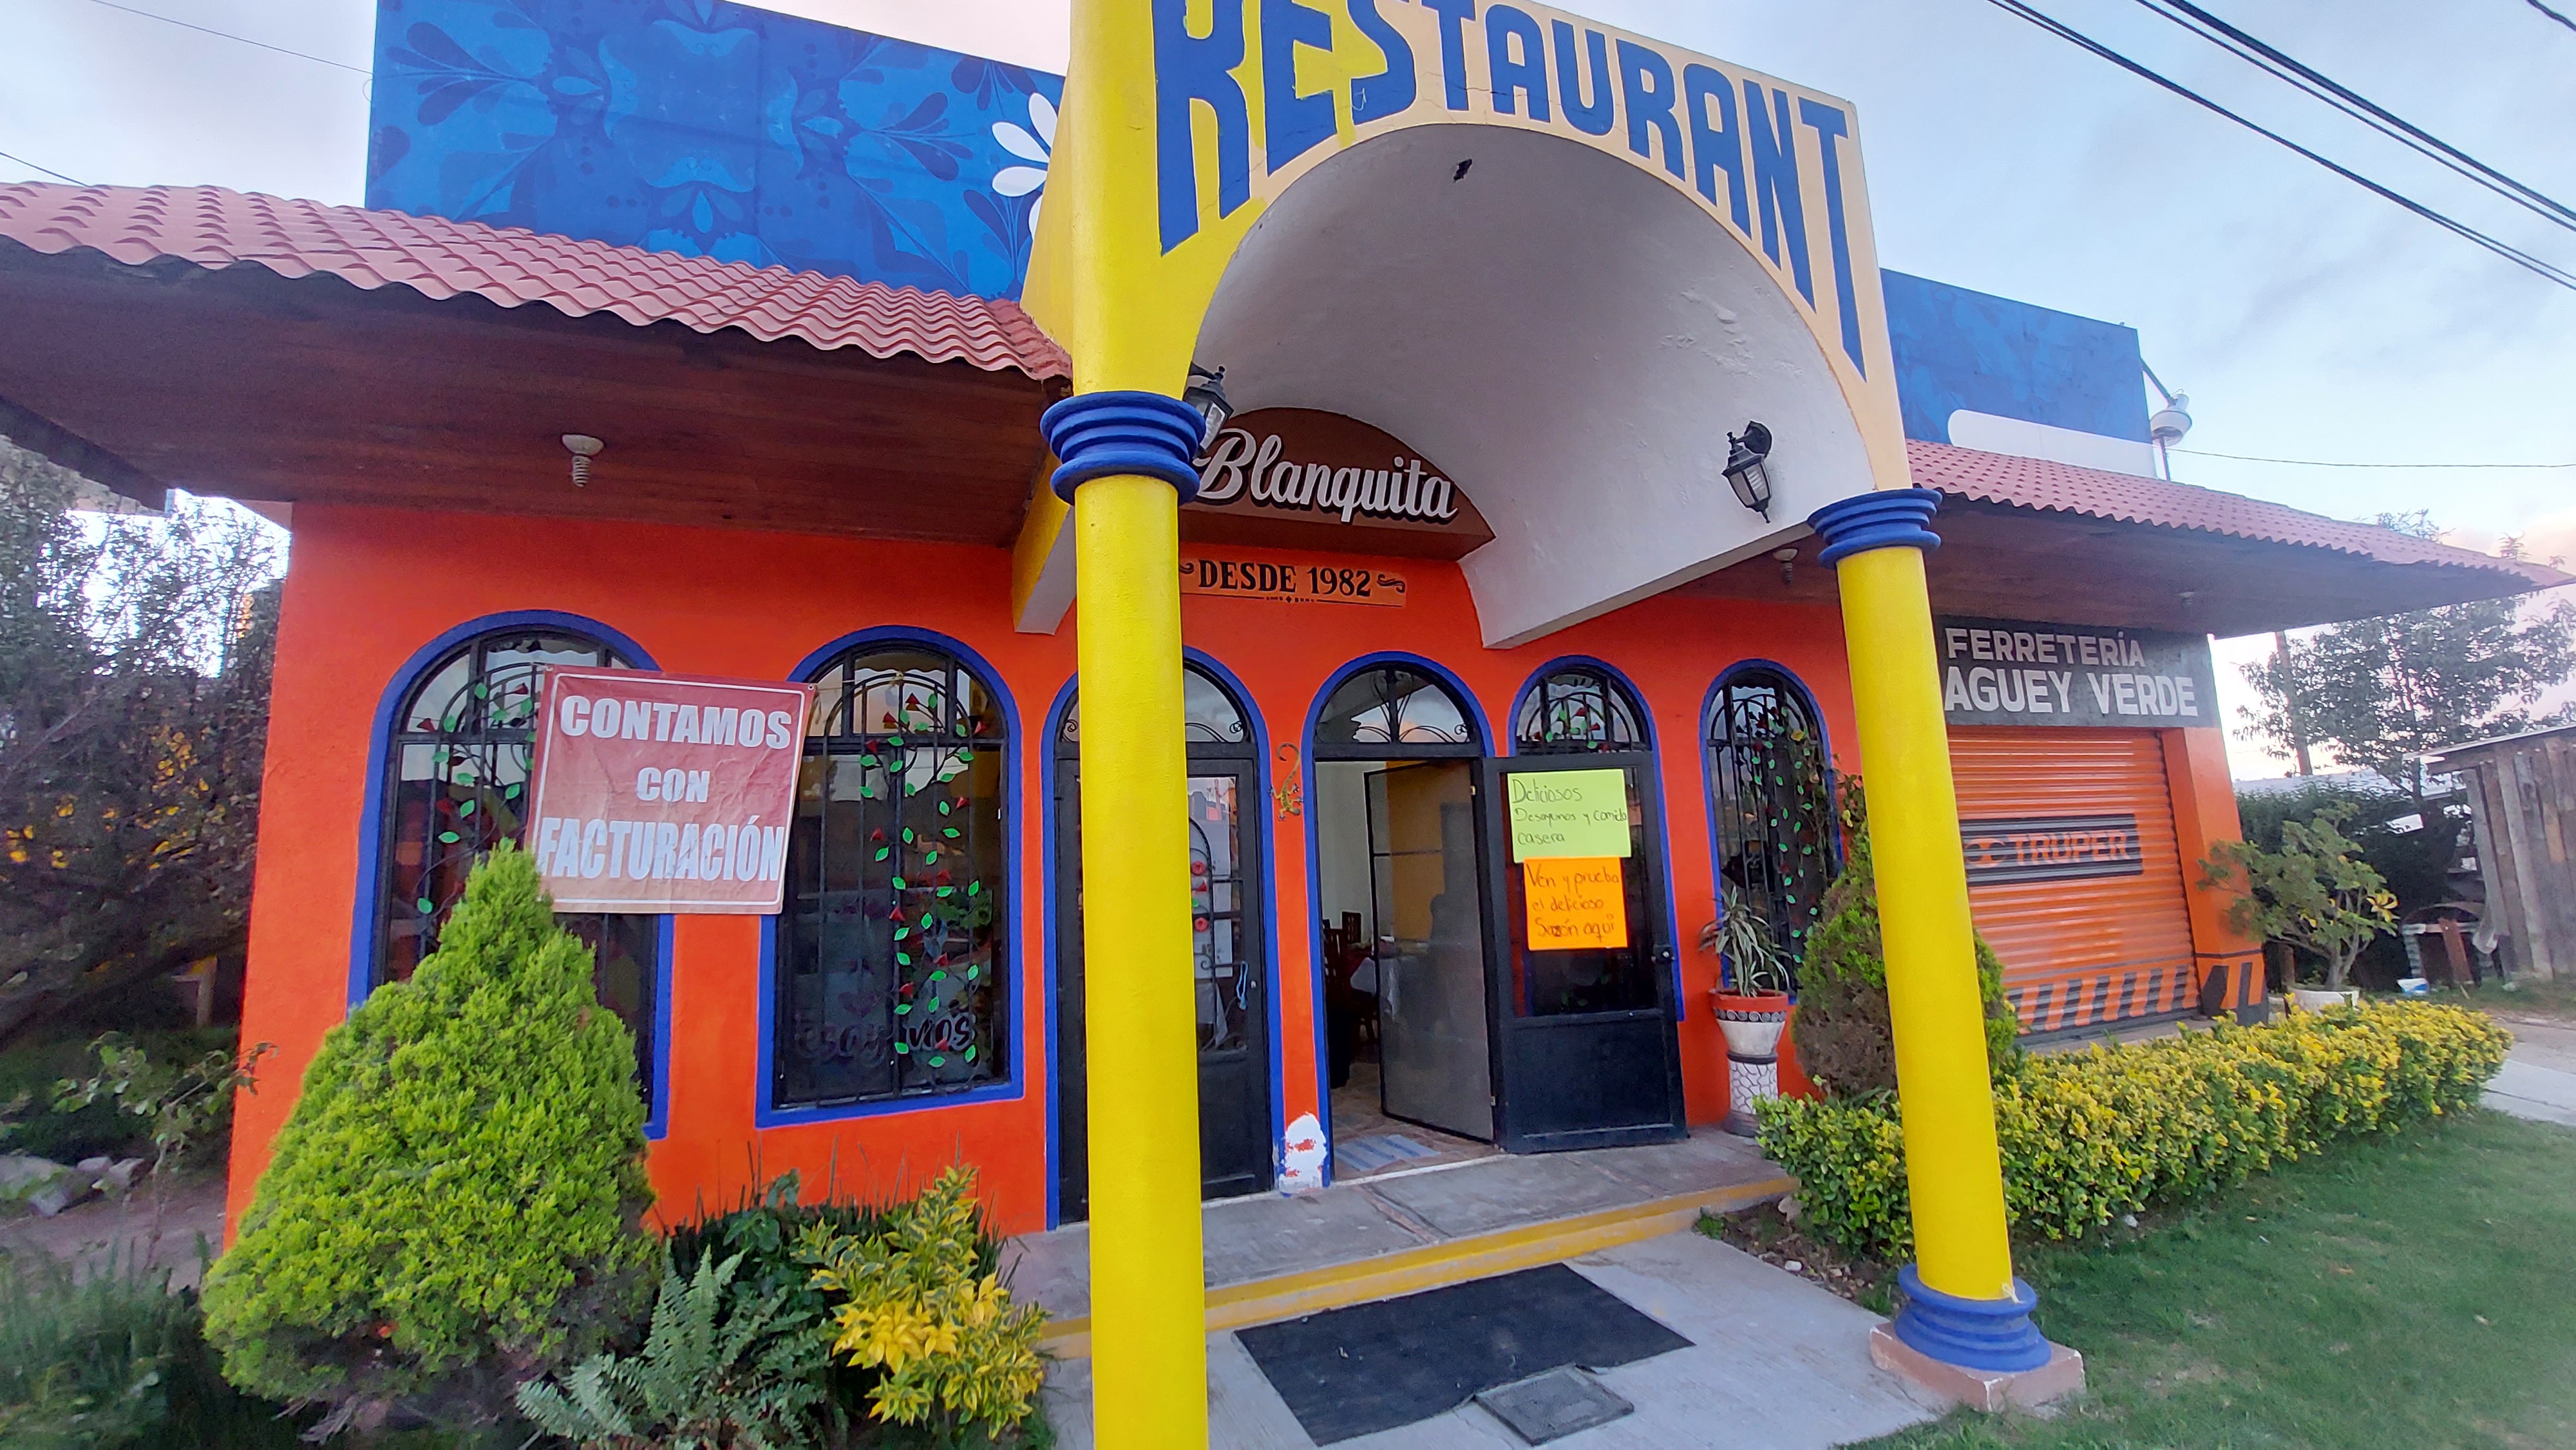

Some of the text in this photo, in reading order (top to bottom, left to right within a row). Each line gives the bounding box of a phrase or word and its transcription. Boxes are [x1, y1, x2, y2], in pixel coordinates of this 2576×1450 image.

[1153, 0, 1866, 383] RESTAURANT
[1193, 428, 1458, 522] Blanquita
[1198, 560, 1371, 597] DESDE 1982
[1946, 628, 2146, 667] FERRETERÍA
[1945, 666, 2198, 717] AGUEY VERDE
[560, 695, 792, 749] CONTAMOS
[636, 767, 710, 802] CON
[1512, 778, 1582, 804] Deliciosos
[1515, 808, 1576, 830] Desayunos
[1583, 813, 1591, 825] y
[537, 815, 784, 882] FACTURACIÓN
[1518, 832, 1565, 845] casera
[2006, 830, 2130, 866] TRUPER
[1527, 864, 1619, 894] Ven y prueba
[1532, 895, 1604, 912] el delicioso
